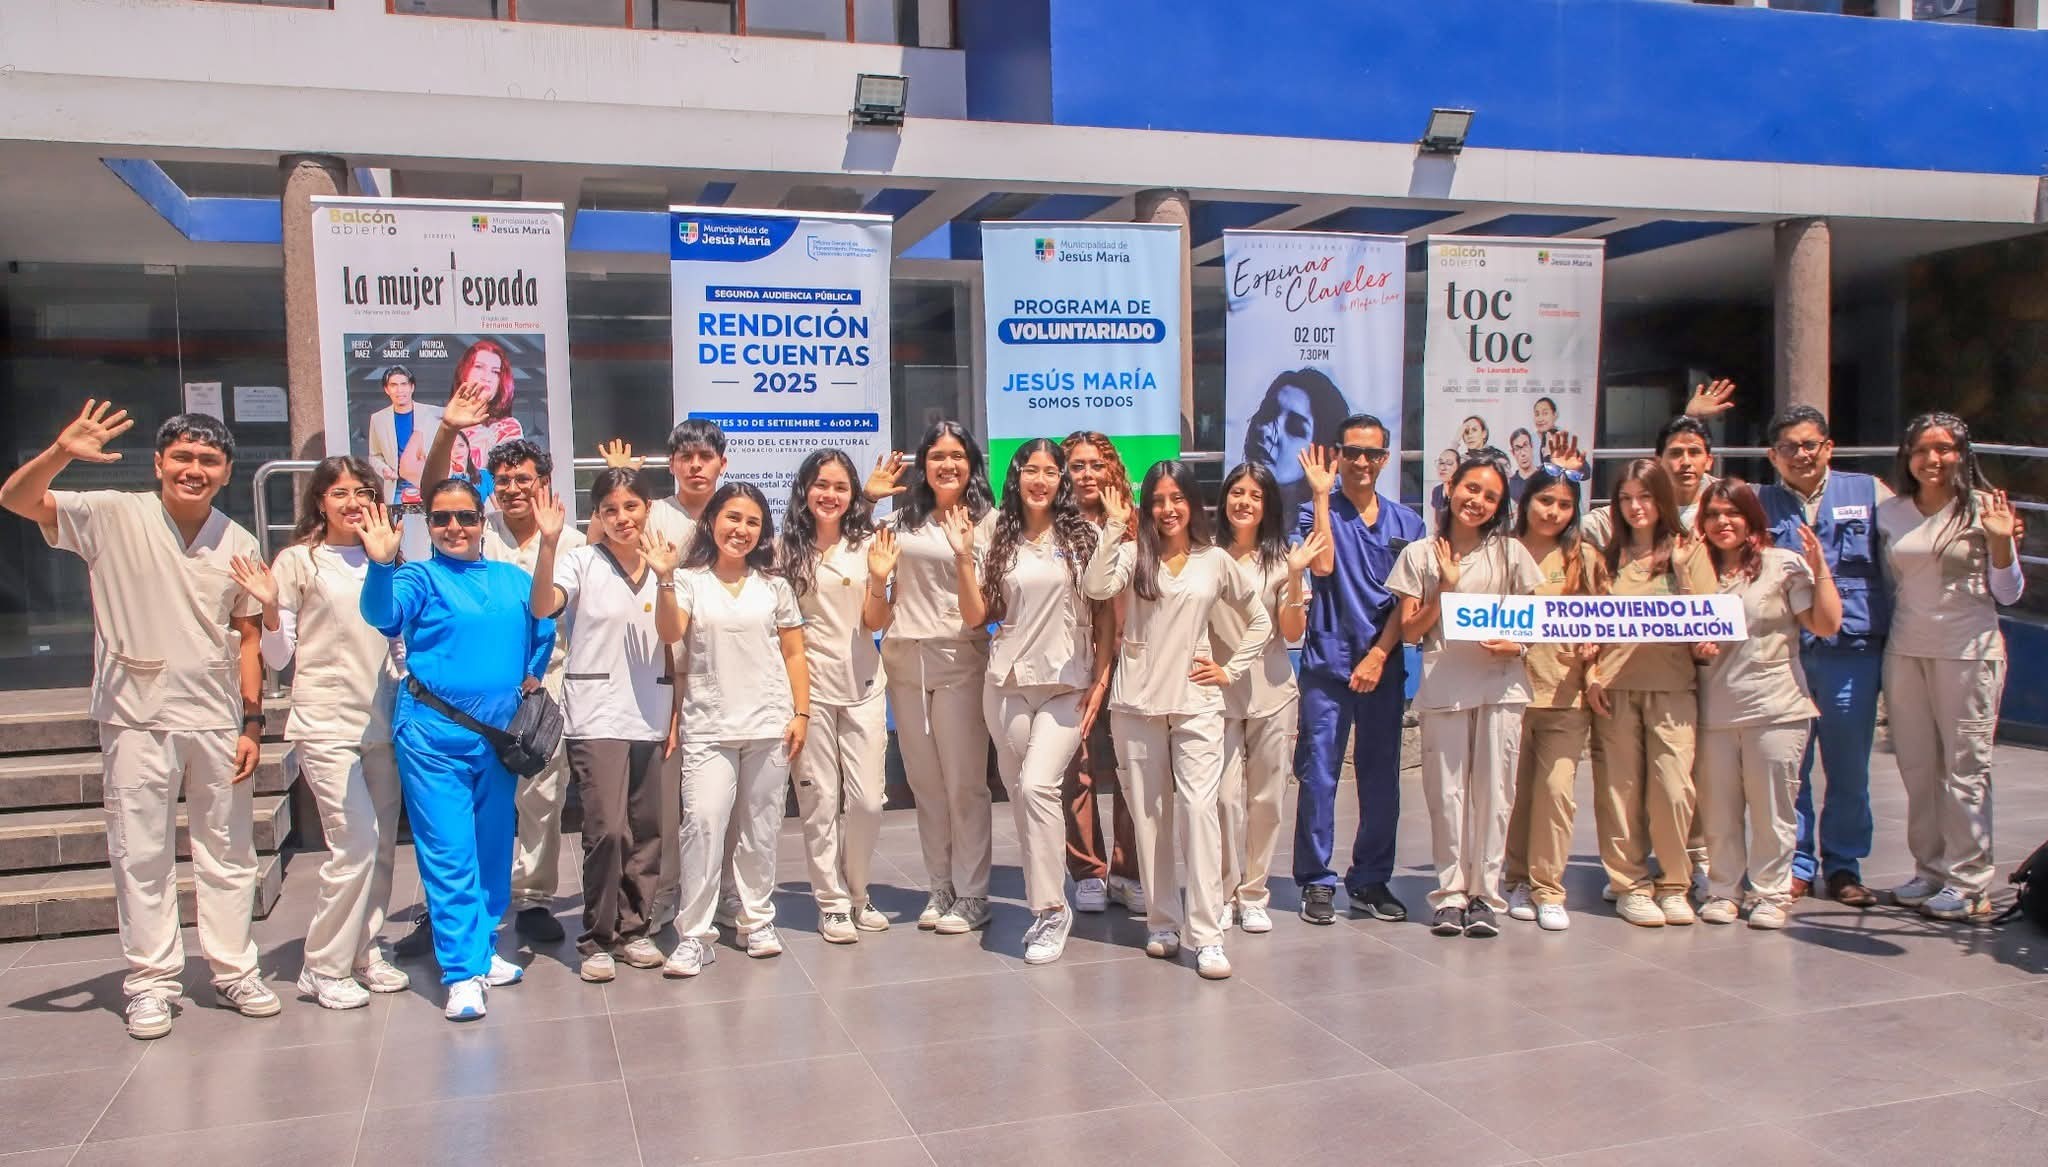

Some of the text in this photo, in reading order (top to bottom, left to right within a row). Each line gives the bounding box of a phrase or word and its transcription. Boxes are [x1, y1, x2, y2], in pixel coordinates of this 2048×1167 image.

[329, 208, 396, 224] Balcón
[331, 224, 397, 236] abierto
[491, 225, 552, 236] Jesús María
[703, 224, 769, 235] Municipalidad de
[702, 233, 771, 247] Jesús María
[1060, 240, 1128, 250] Municipalidad de
[1058, 250, 1130, 263] Jesús María
[1233, 255, 1334, 298] Espinas
[343, 266, 538, 311] La mujer espada
[714, 289, 853, 301] SEGUNDA AUDIENCIA PÚBLICA
[1286, 265, 1392, 312] Claveles
[1014, 299, 1151, 315] PROGRAMA DE
[1444, 281, 1513, 321] toc
[699, 308, 868, 339] RENDICIÓN
[1009, 322, 1156, 340] VOLUNTARIADO
[1294, 327, 1335, 344] 02 OCT
[1466, 324, 1533, 363] toc
[699, 343, 870, 367] DE CUENTAS
[1299, 349, 1329, 360] 7.30PM
[753, 372, 818, 394] 2025
[1003, 367, 1157, 392] JESÚS MARÍA
[1028, 396, 1133, 409] SOMOS TODOS
[737, 419, 748, 427] 30
[752, 419, 764, 427] DE
[768, 419, 820, 428] SETIEMBRE
[829, 419, 851, 428] 6:00
[854, 420, 874, 428] P.M.
[758, 438, 776, 446] DEL
[779, 438, 818, 446] CENTRO
[821, 438, 870, 447] CULTURAL
[724, 471, 760, 480] Avances
[762, 472, 773, 480] de
[776, 472, 783, 480] la
[1456, 603, 1534, 629] salud
[1545, 600, 1715, 618] PROMOVIENDO LA
[1541, 617, 1733, 638] SALUD DE LA POBLACIÓN
